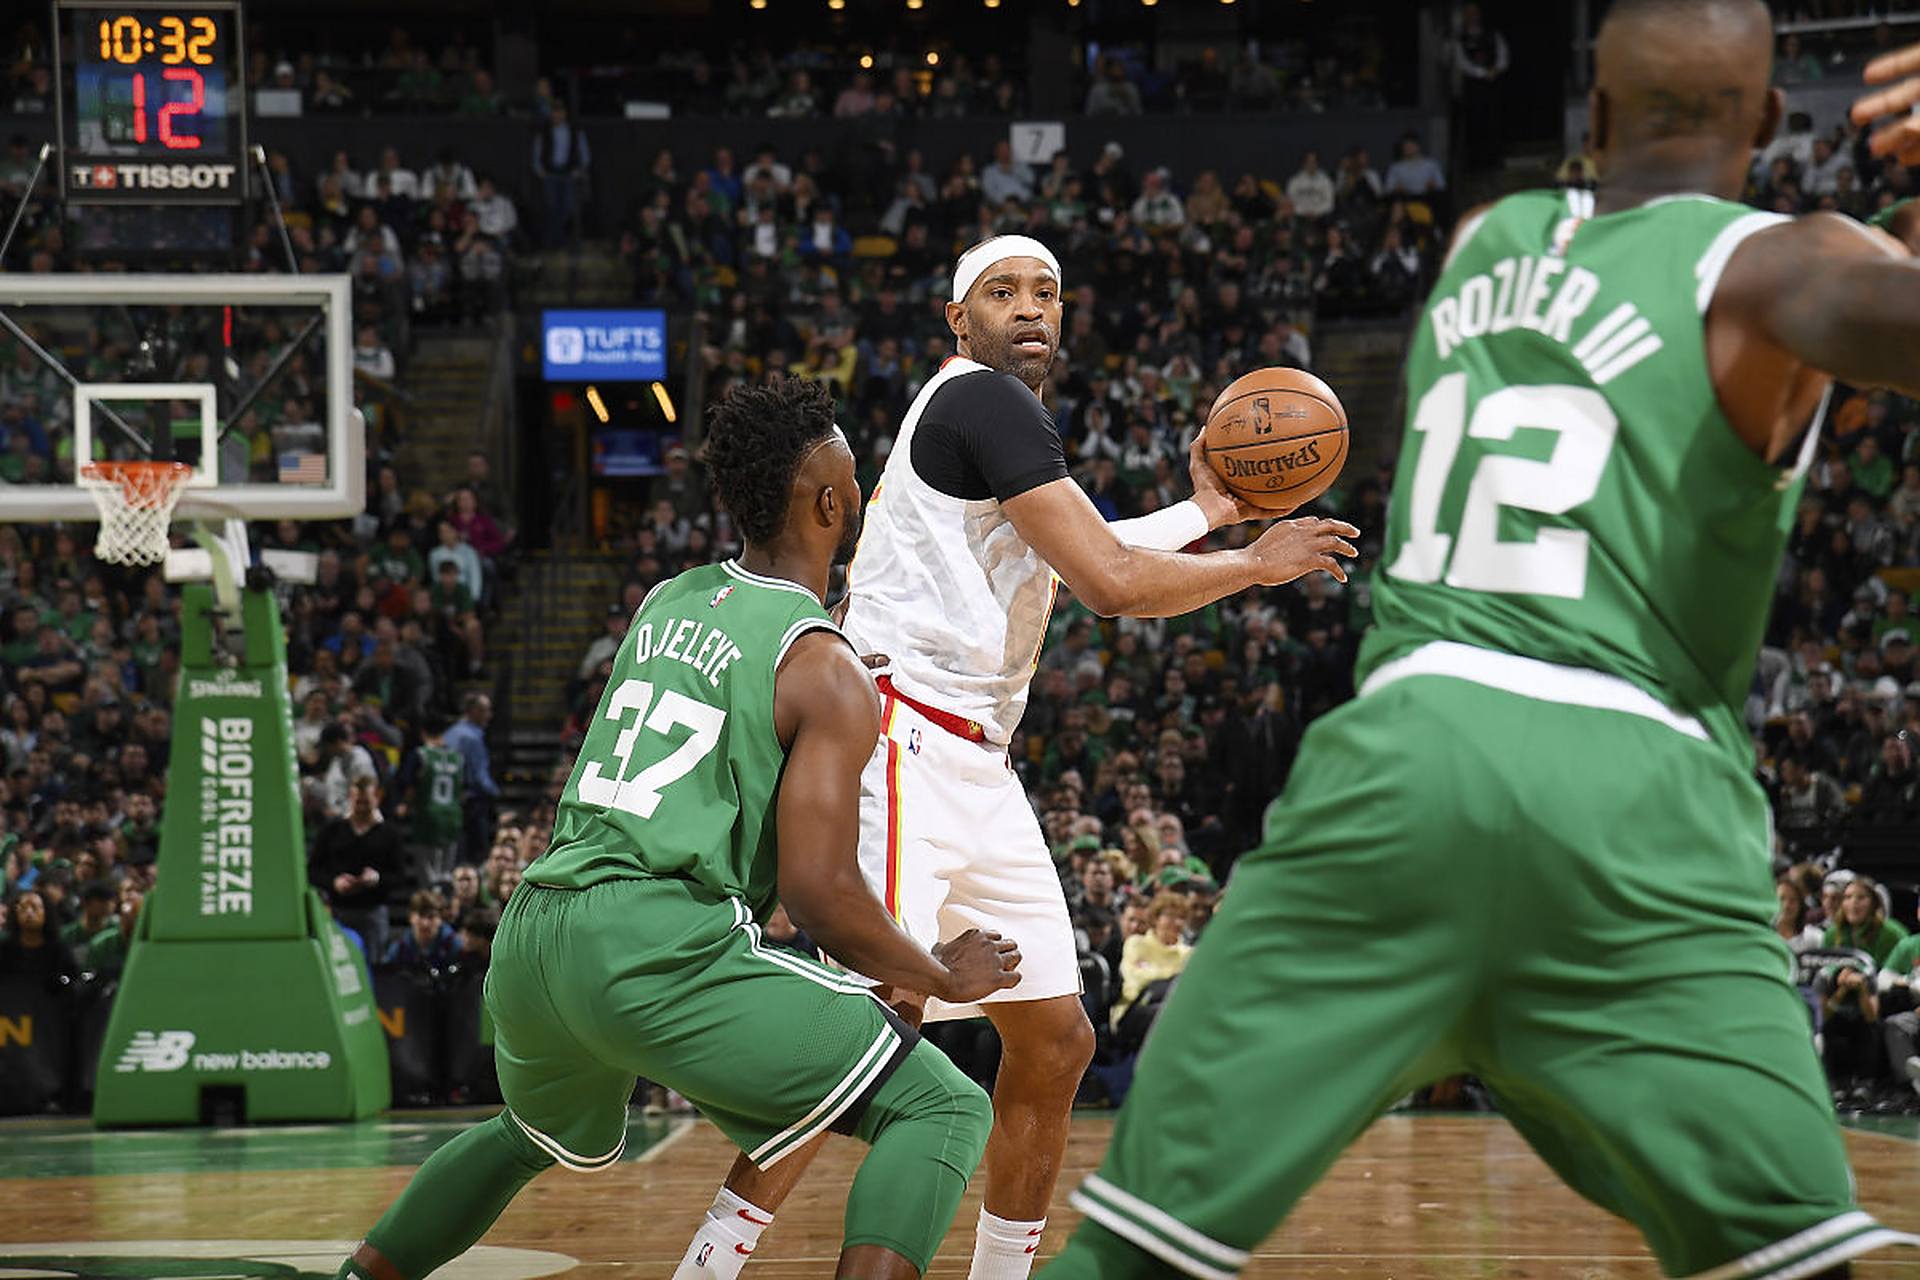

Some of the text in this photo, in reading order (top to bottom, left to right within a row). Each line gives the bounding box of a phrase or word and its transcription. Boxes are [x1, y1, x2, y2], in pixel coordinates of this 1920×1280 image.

[100, 16, 217, 65] 10:32
[132, 68, 205, 149] 12
[1028, 128, 1045, 157] 7
[118, 164, 236, 189] TISSOT
[584, 327, 662, 349] TUFTS
[1431, 255, 1664, 385] ROZIER III
[1223, 440, 1321, 478] SPALDING
[1386, 371, 1619, 600] 12
[635, 618, 743, 688] OJELEYE
[577, 679, 728, 820] 37
[432, 774, 454, 804] 0
[219, 717, 253, 916] BIOFREEZE
[201, 832, 217, 864] THE
[201, 872, 217, 915] PAIN
[193, 1049, 331, 1071] new balance
